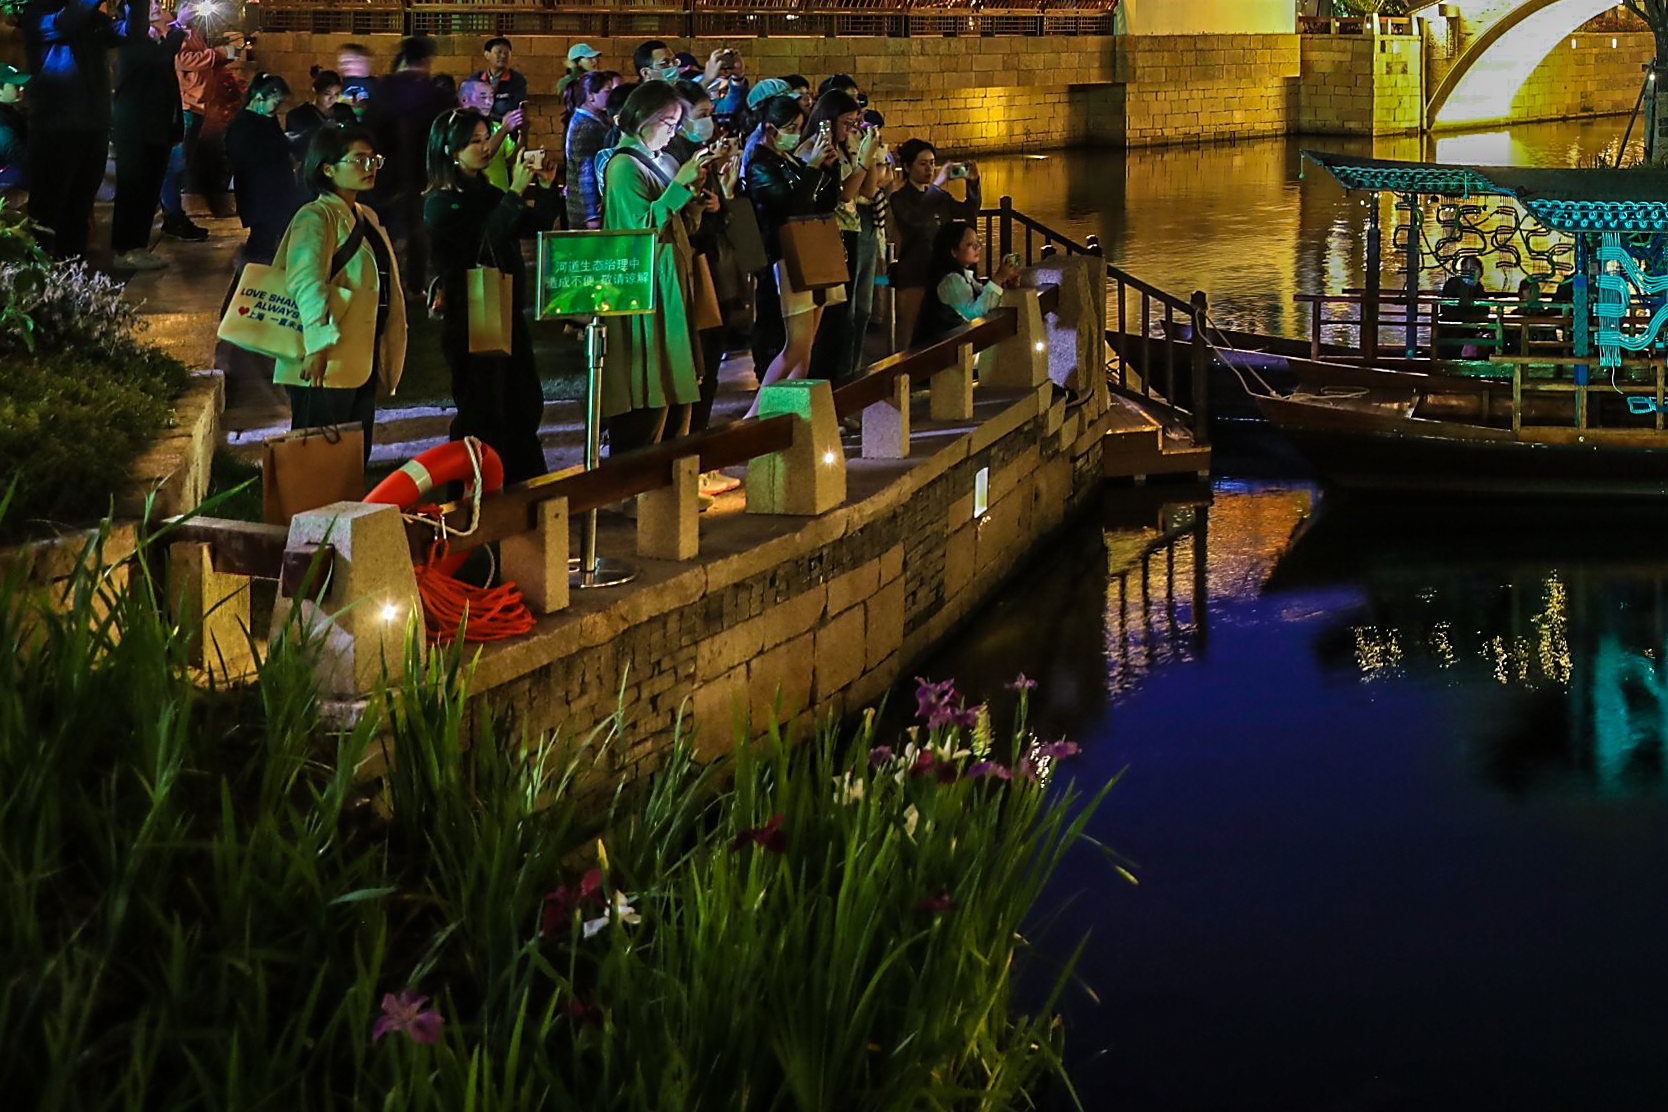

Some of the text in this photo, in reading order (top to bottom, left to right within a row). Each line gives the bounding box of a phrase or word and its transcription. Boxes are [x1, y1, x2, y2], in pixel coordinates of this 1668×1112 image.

[556, 258, 640, 273] 河道生态治理中
[548, 272, 649, 288] 造成不便 敬请谅解
[241, 288, 267, 299] LOVE
[247, 311, 265, 321] 上海
[254, 301, 301, 319] ALWAYS
